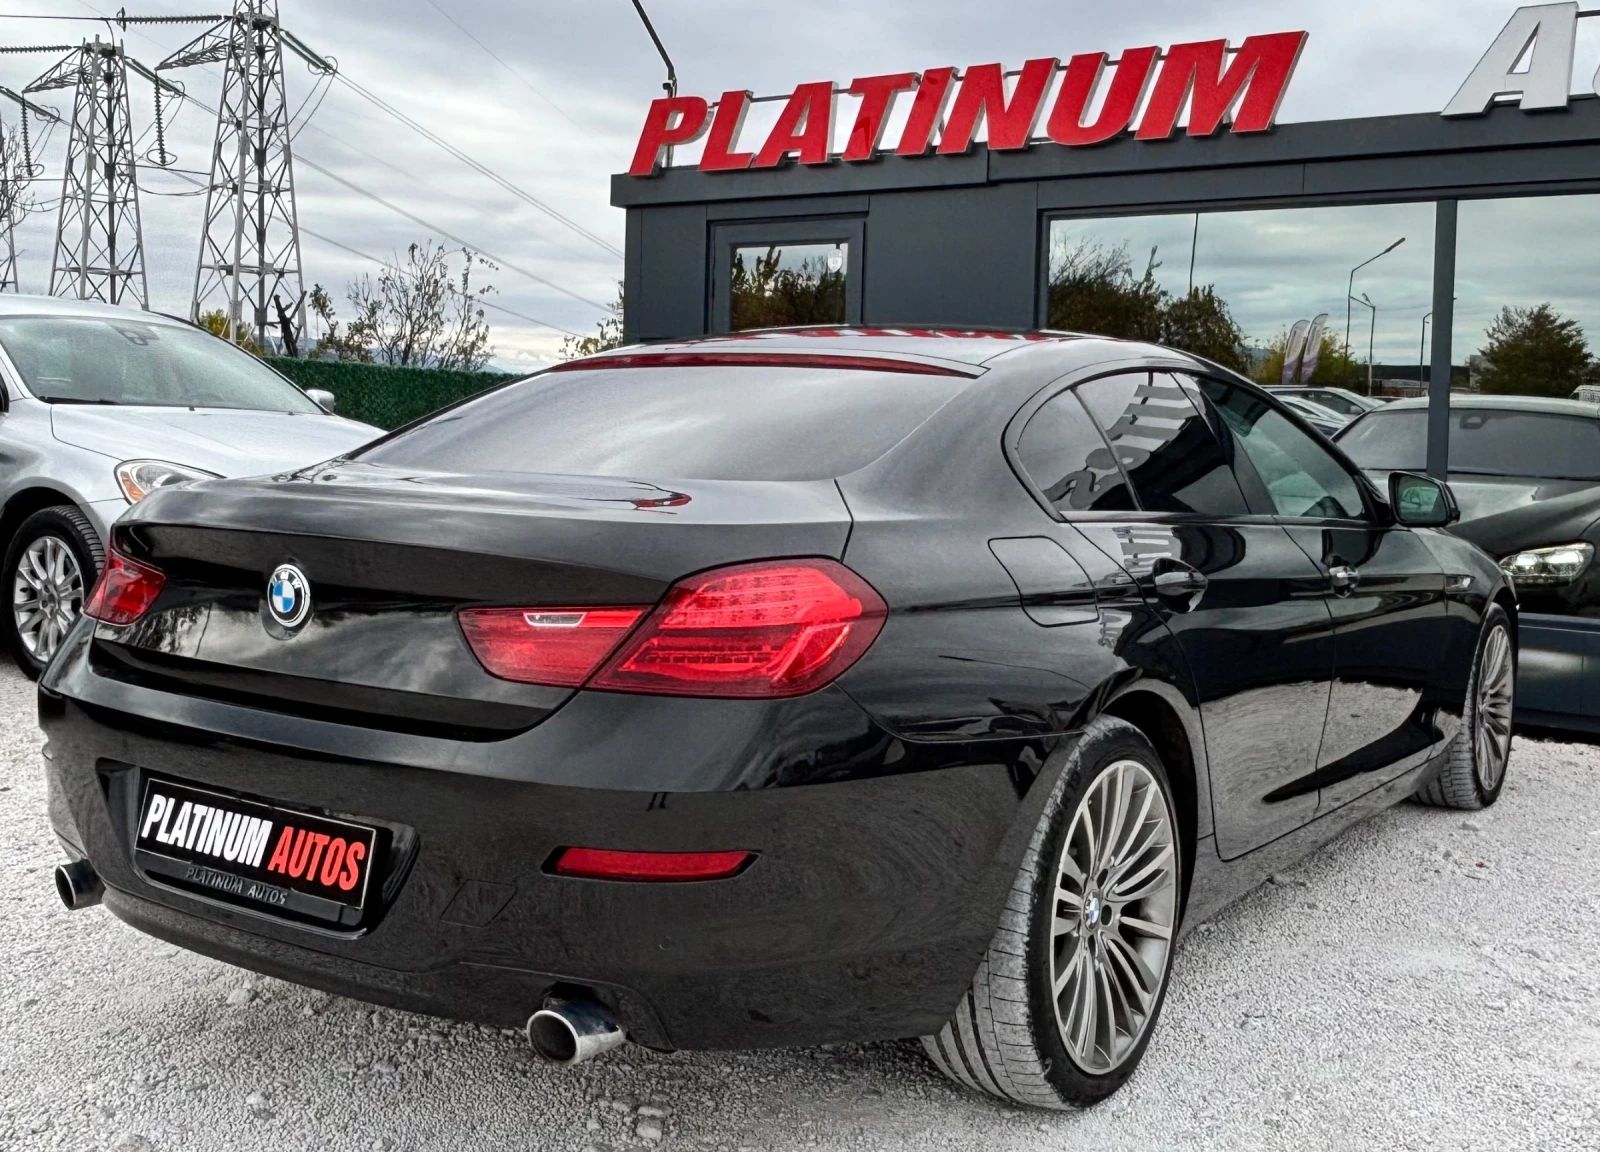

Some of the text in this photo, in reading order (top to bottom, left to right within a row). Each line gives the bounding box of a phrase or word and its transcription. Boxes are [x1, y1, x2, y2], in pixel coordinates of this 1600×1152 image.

[629, 1, 1600, 176] PLATINUM A
[141, 794, 366, 891] PLATINUM AUTOS
[185, 867, 288, 905] PLATINUM AUTOS
